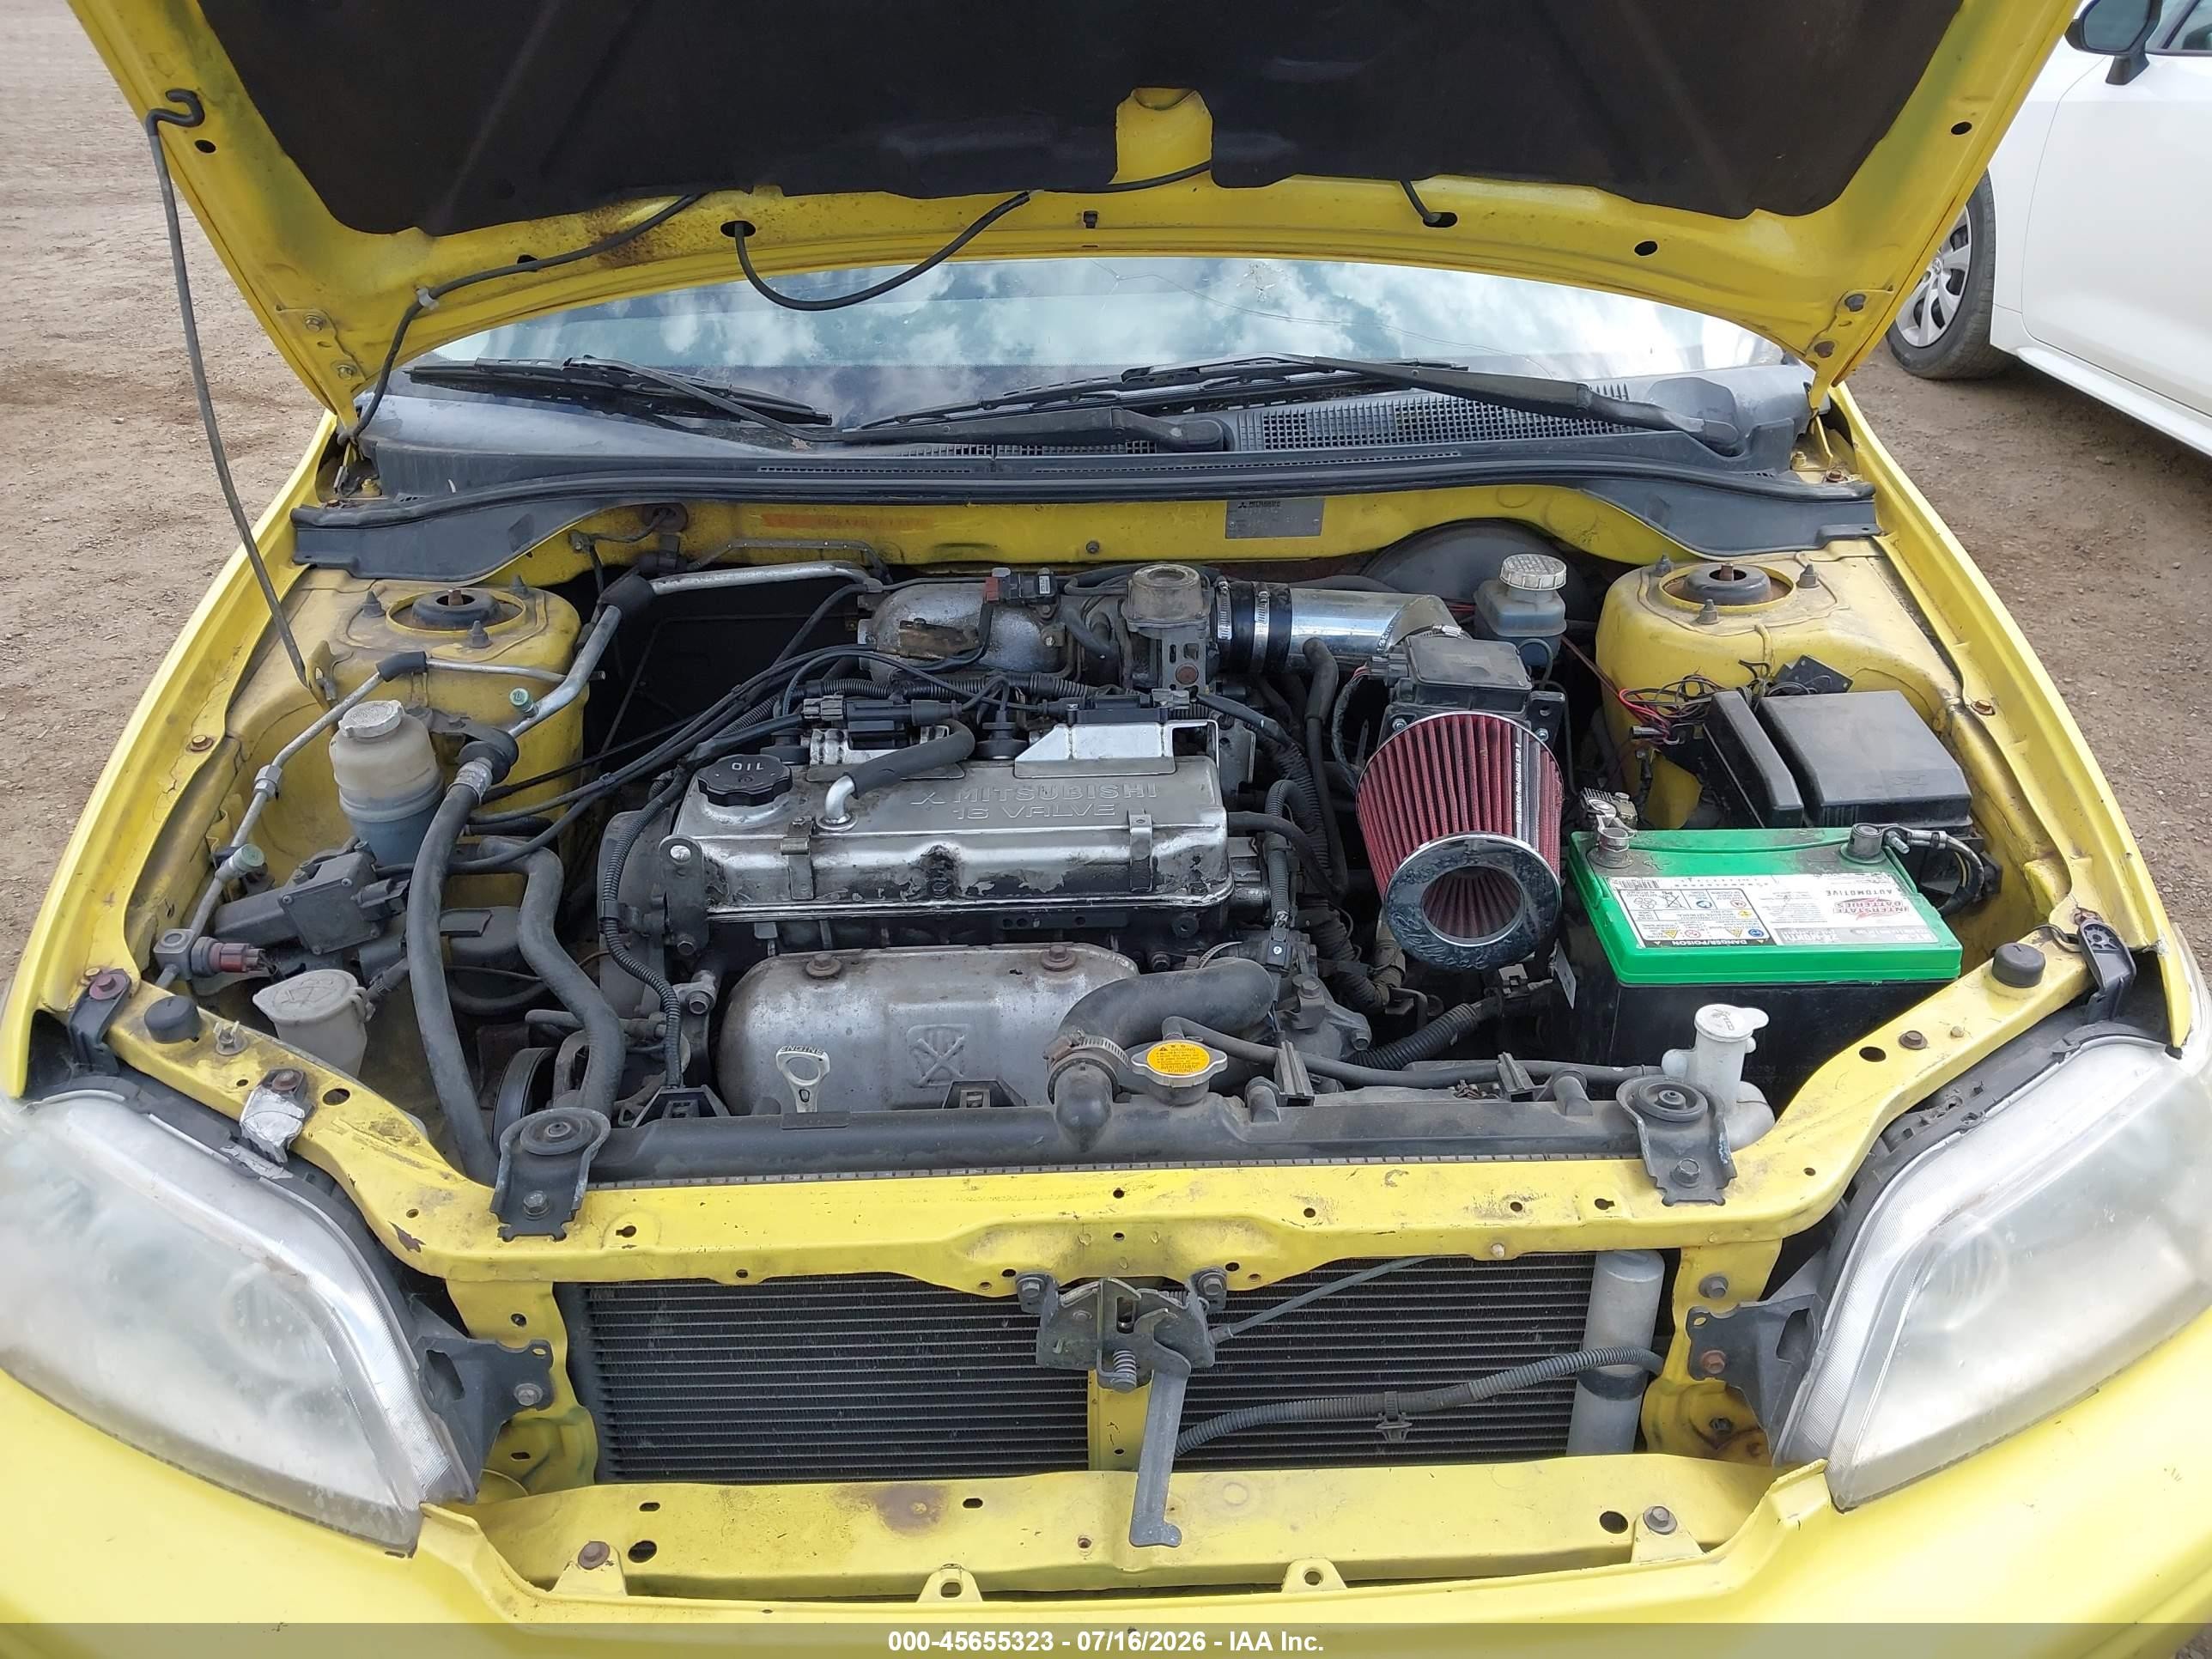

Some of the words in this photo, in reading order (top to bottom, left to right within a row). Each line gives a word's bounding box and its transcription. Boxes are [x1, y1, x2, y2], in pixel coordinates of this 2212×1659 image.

[731, 761, 765, 772] OIL
[952, 782, 1159, 804] MITSUBISHI
[952, 807, 989, 820] 16
[1002, 803, 1116, 819] VALVE
[1824, 888, 1893, 896] AUTOMOTIVE
[1834, 899, 1902, 908] BATTERIES
[1832, 905, 1909, 915] INTERSTATE
[1671, 939, 1747, 947] DANGER/POISON
[780, 1044, 825, 1056] ENGINE
